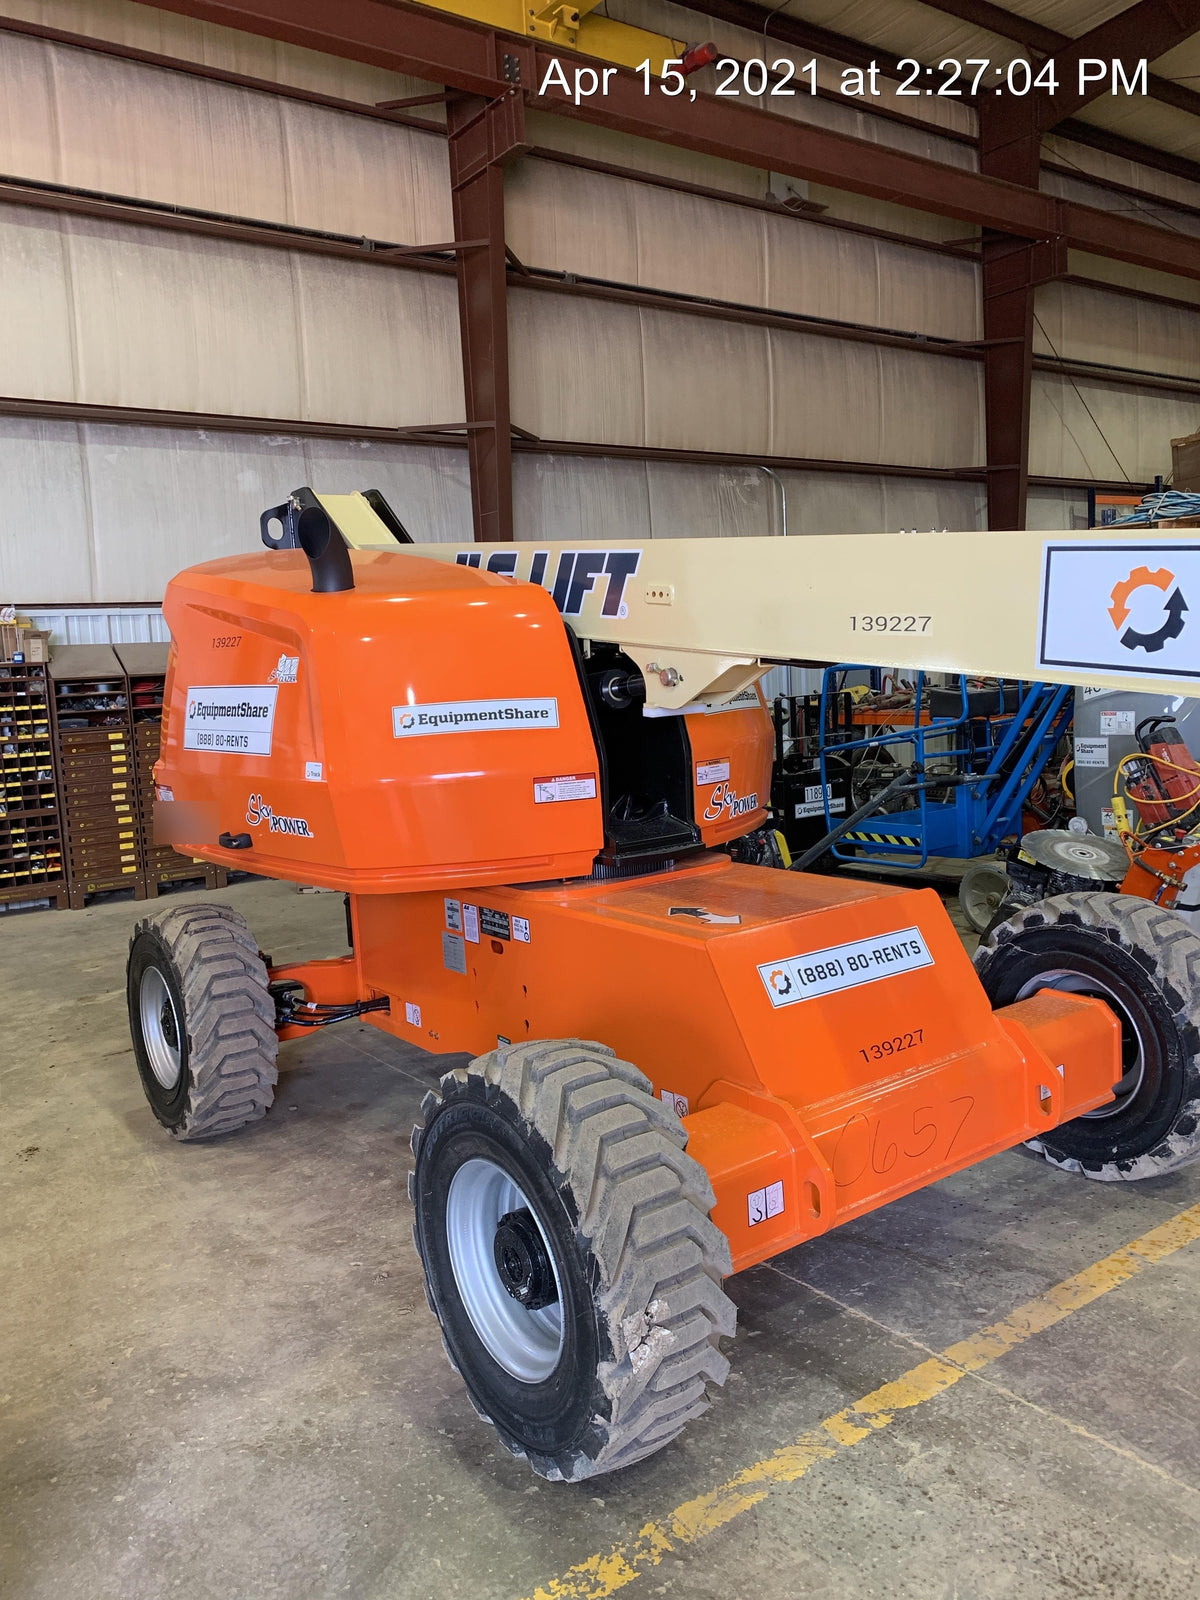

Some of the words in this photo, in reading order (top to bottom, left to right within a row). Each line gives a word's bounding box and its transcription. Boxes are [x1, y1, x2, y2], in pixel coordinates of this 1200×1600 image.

[849, 615, 932, 632] 139227
[211, 636, 242, 649] 139227
[196, 702, 269, 720] EquipmentShare
[418, 707, 549, 727] EquipmentShare
[196, 733, 215, 747] (888)
[215, 734, 249, 748] 80-RENTS
[704, 784, 736, 819] Sky
[805, 785, 831, 801] 11890
[247, 794, 273, 831] Sky
[733, 793, 758, 815] POWER
[271, 815, 311, 837] POWER
[797, 959, 844, 986] (888)
[846, 940, 921, 973] 80-RENTS
[859, 1028, 925, 1063] 139227
